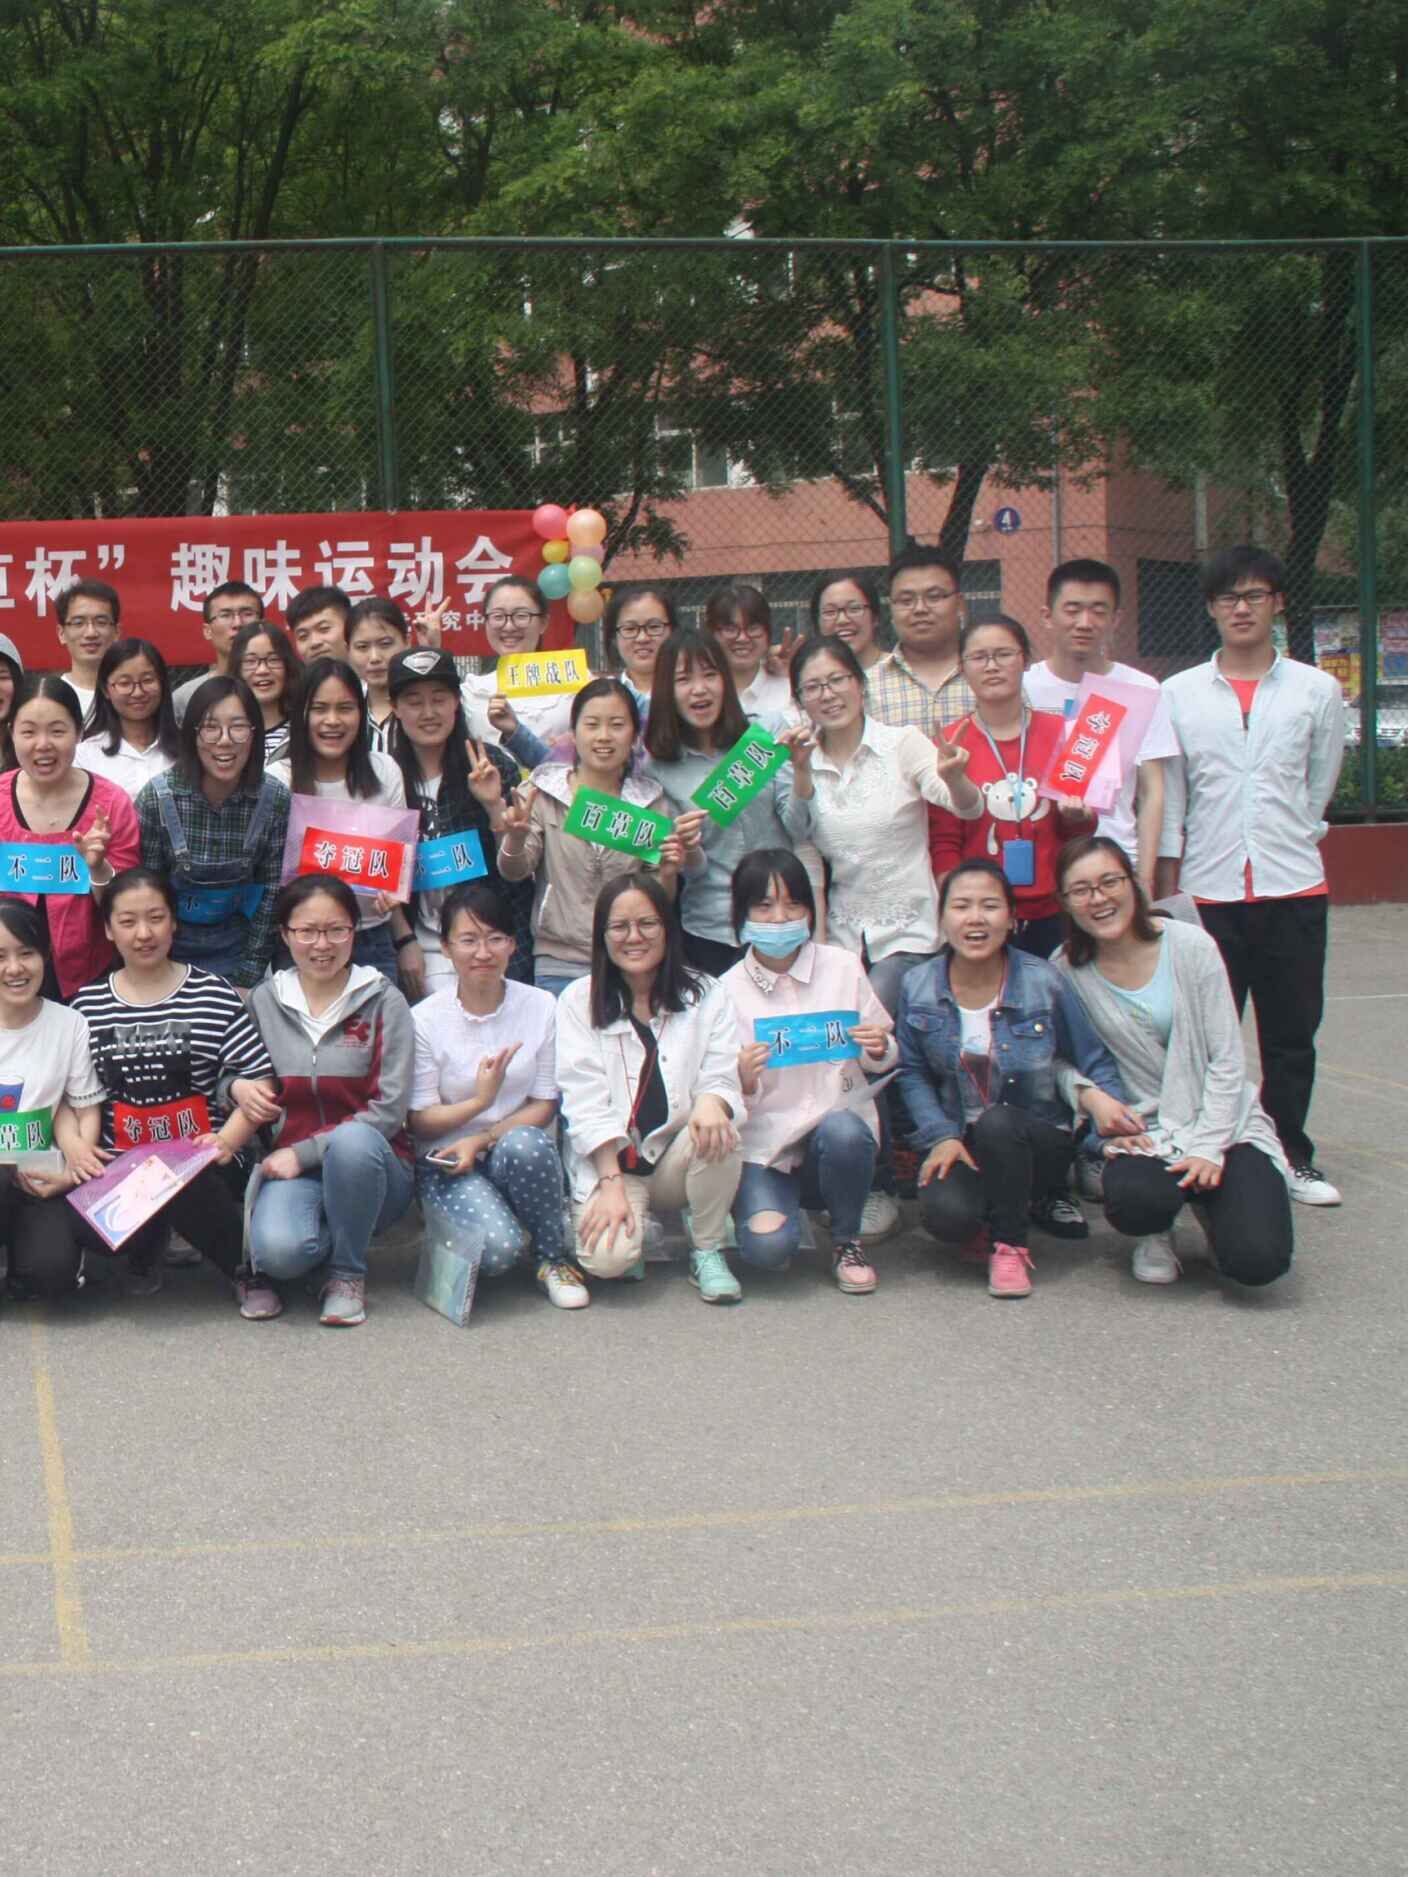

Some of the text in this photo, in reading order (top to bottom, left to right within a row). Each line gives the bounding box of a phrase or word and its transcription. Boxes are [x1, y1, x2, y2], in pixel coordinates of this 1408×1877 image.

[506, 658, 580, 689] 王牌战队
[1059, 710, 1112, 783] 夺冠队
[707, 740, 775, 810] 百草队
[582, 801, 656, 849] 百草队
[8, 854, 81, 884] 不二队
[314, 840, 389, 879] 夺冠队
[768, 1019, 848, 1057] 不二队
[123, 1109, 200, 1144] 夺冠队
